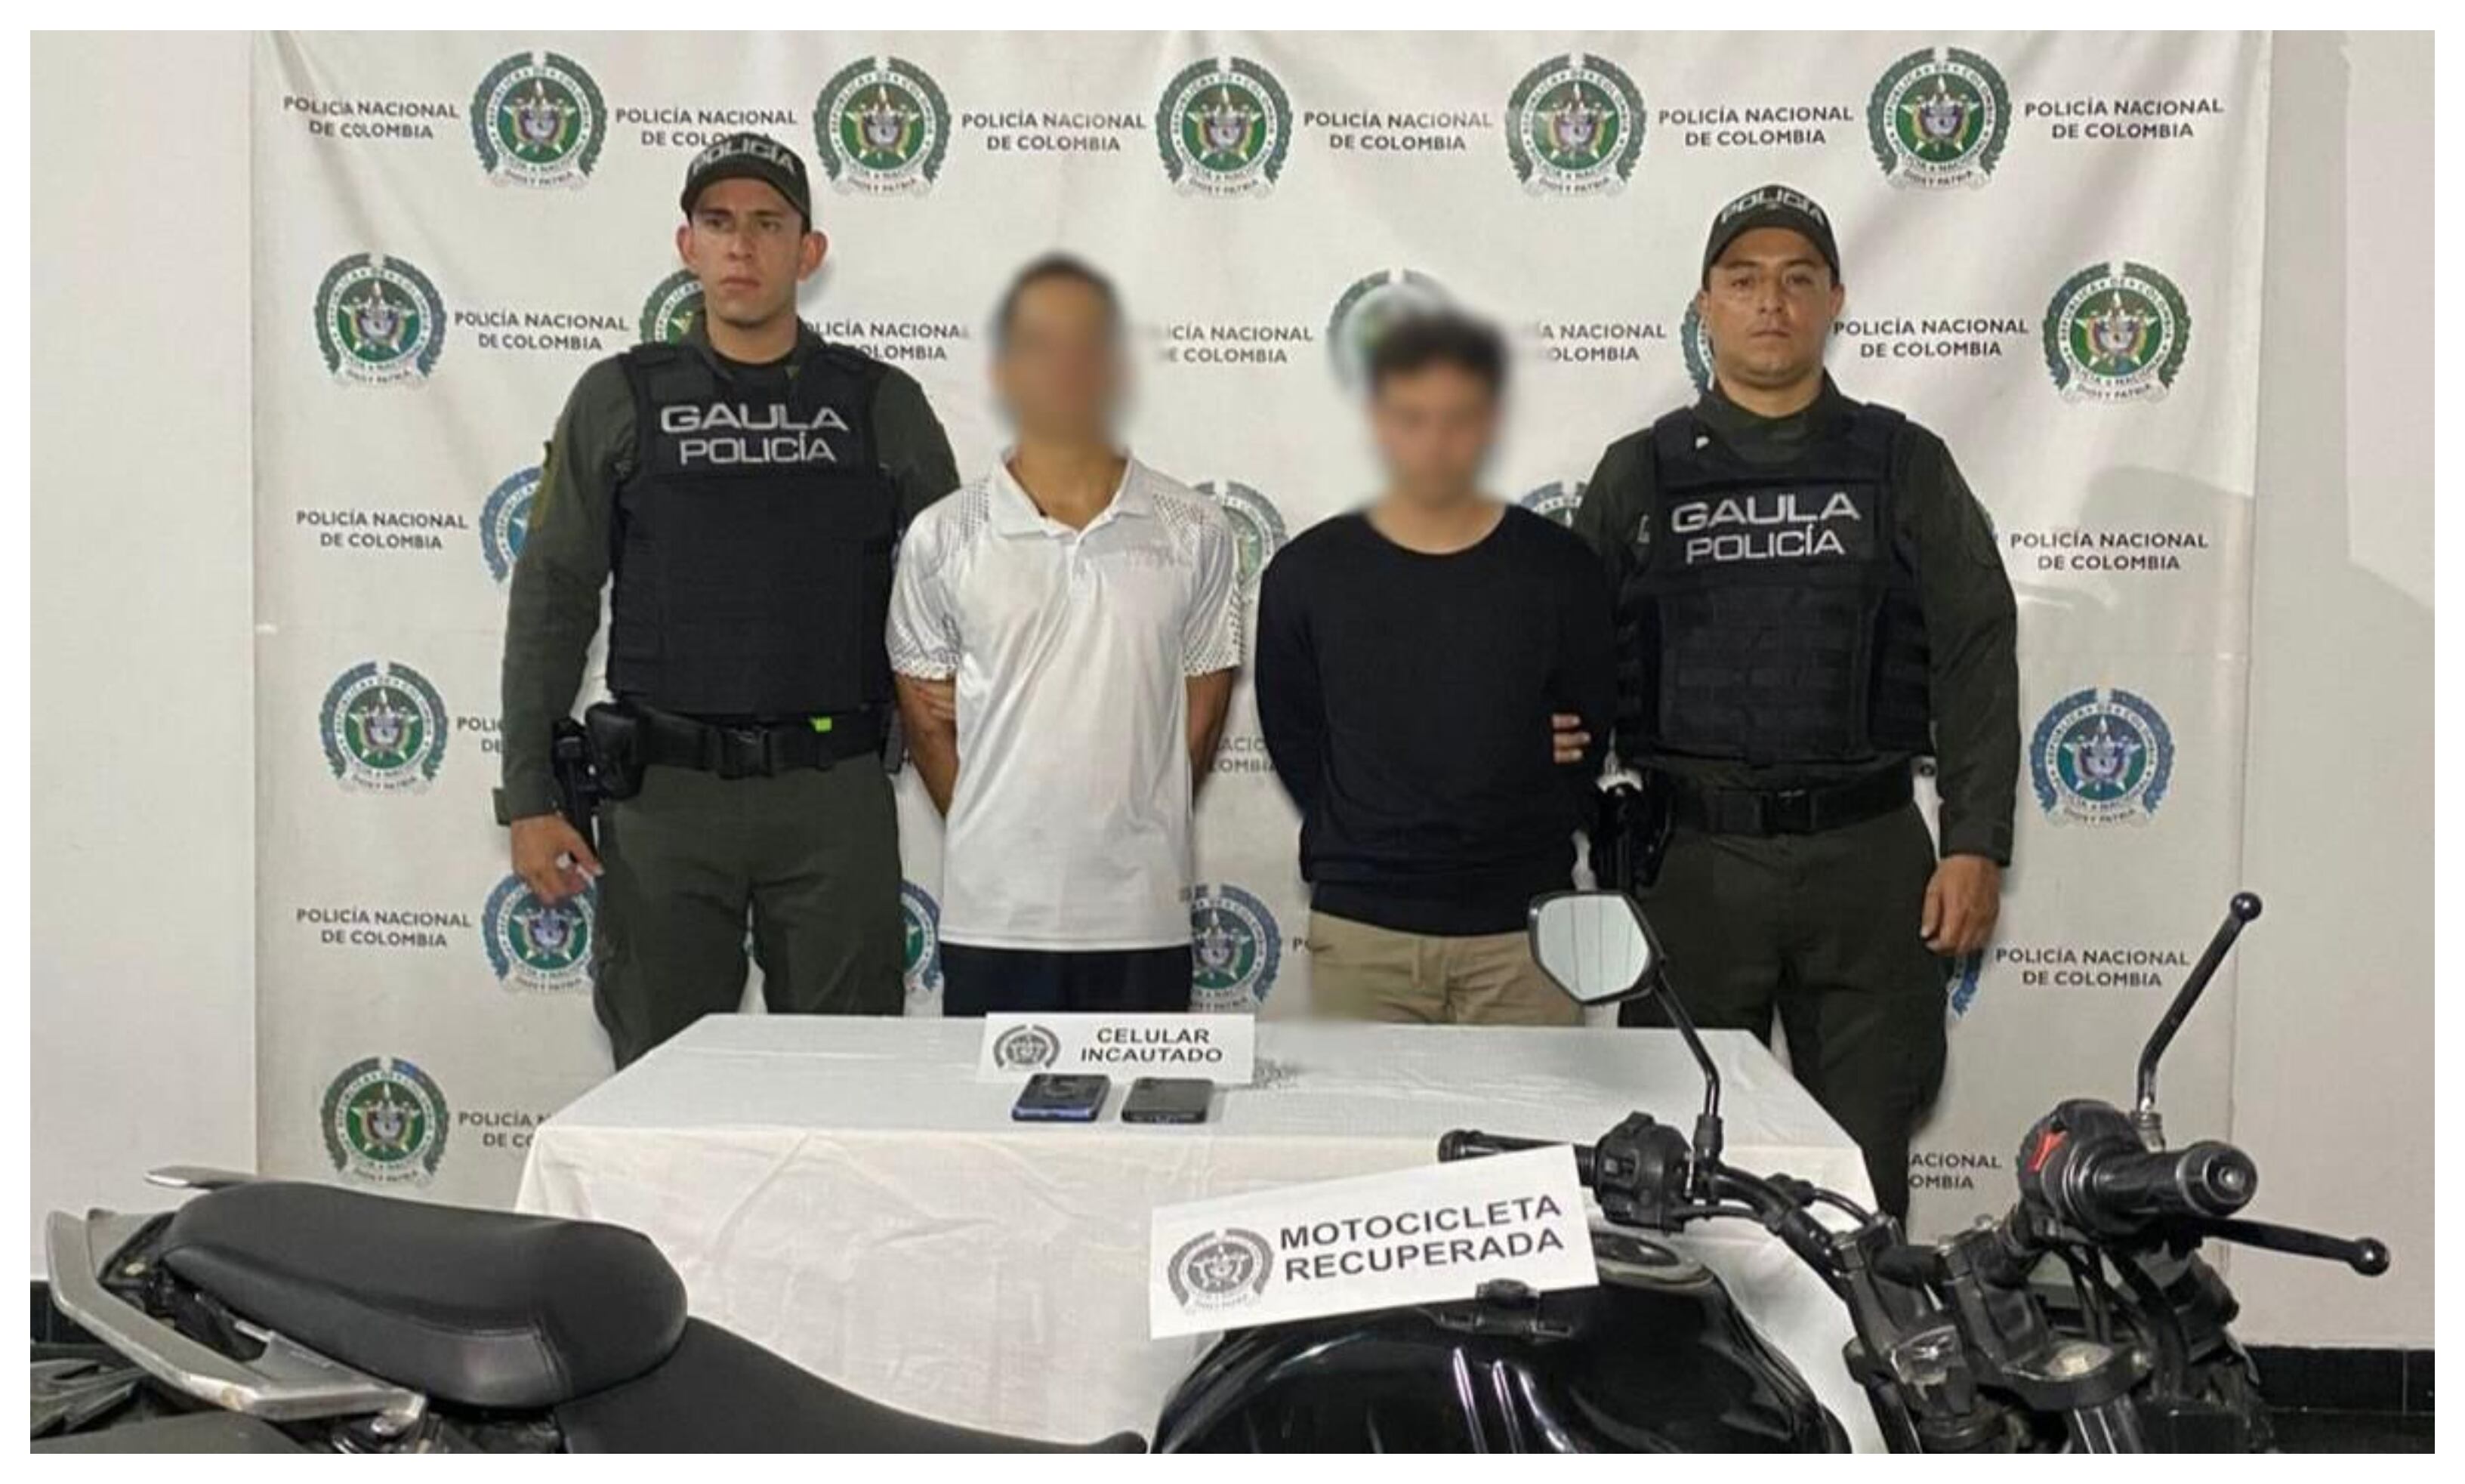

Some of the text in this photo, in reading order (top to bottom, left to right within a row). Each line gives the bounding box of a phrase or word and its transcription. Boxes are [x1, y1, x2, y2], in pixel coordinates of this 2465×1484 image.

[357, 101, 459, 119] NACIONAL
[1659, 106, 1853, 124] POLICÍA NACIONAL
[2025, 98, 2224, 117] POLICÍA NACIONAL
[615, 108, 797, 125] POLICÍA NACIONAL
[961, 110, 1146, 128] POLICÍA NACIONAL
[1304, 109, 1493, 128] POLICÍA NACIONAL
[308, 121, 433, 139] DE COLOMBIA
[641, 131, 668, 146] DE
[1685, 130, 1825, 146] DE COLOMBIA
[2052, 123, 2193, 139] DE COLOMBIA
[987, 136, 1121, 151] DE COLOMBIA
[1329, 135, 1465, 150] DE COLOMBIA
[455, 308, 628, 331] POLICÍA NACIONAL
[1834, 317, 2029, 335] POLICÍA NACIONAL
[1211, 325, 1313, 341] NACIONAL
[1560, 324, 1666, 338] NACIONAL
[479, 335, 602, 350] DE COLOMBIA
[1860, 341, 2002, 358] DE COLOMBIA
[859, 344, 946, 359] OLOMBIA
[1183, 347, 1288, 363] COLOMBIA
[1550, 347, 1640, 362] OLOMBIA
[661, 403, 849, 433] GAULA
[680, 430, 836, 465] POLICÍA
[297, 509, 468, 529] POLICÍA NACIONAL
[1671, 492, 1861, 532] GAULA
[321, 533, 442, 549] DE COLOMBIA
[1686, 524, 1846, 564] POLICÍA
[2010, 529, 2209, 549] POLICÍA NACIONAL
[2038, 555, 2180, 570] DE COLOMBIA
[297, 906, 471, 927] POLICÍA NACIONAL
[322, 930, 447, 947] DE COLOMBIA
[1996, 946, 2189, 966] POLICÍA NACIONAL
[2022, 970, 2161, 987] DE COLOMBIA
[1097, 1028, 1209, 1044] CELULAR
[1081, 1047, 1223, 1063] INCAUTADO
[458, 1109, 532, 1126] POLICÍA
[483, 1133, 507, 1147] DE
[1911, 1152, 2002, 1168] ACIONAL
[1908, 1174, 1974, 1189] OMBIA
[1281, 1194, 1562, 1250] MOTOCICLETA
[1285, 1228, 1563, 1283] RECUPERADA
